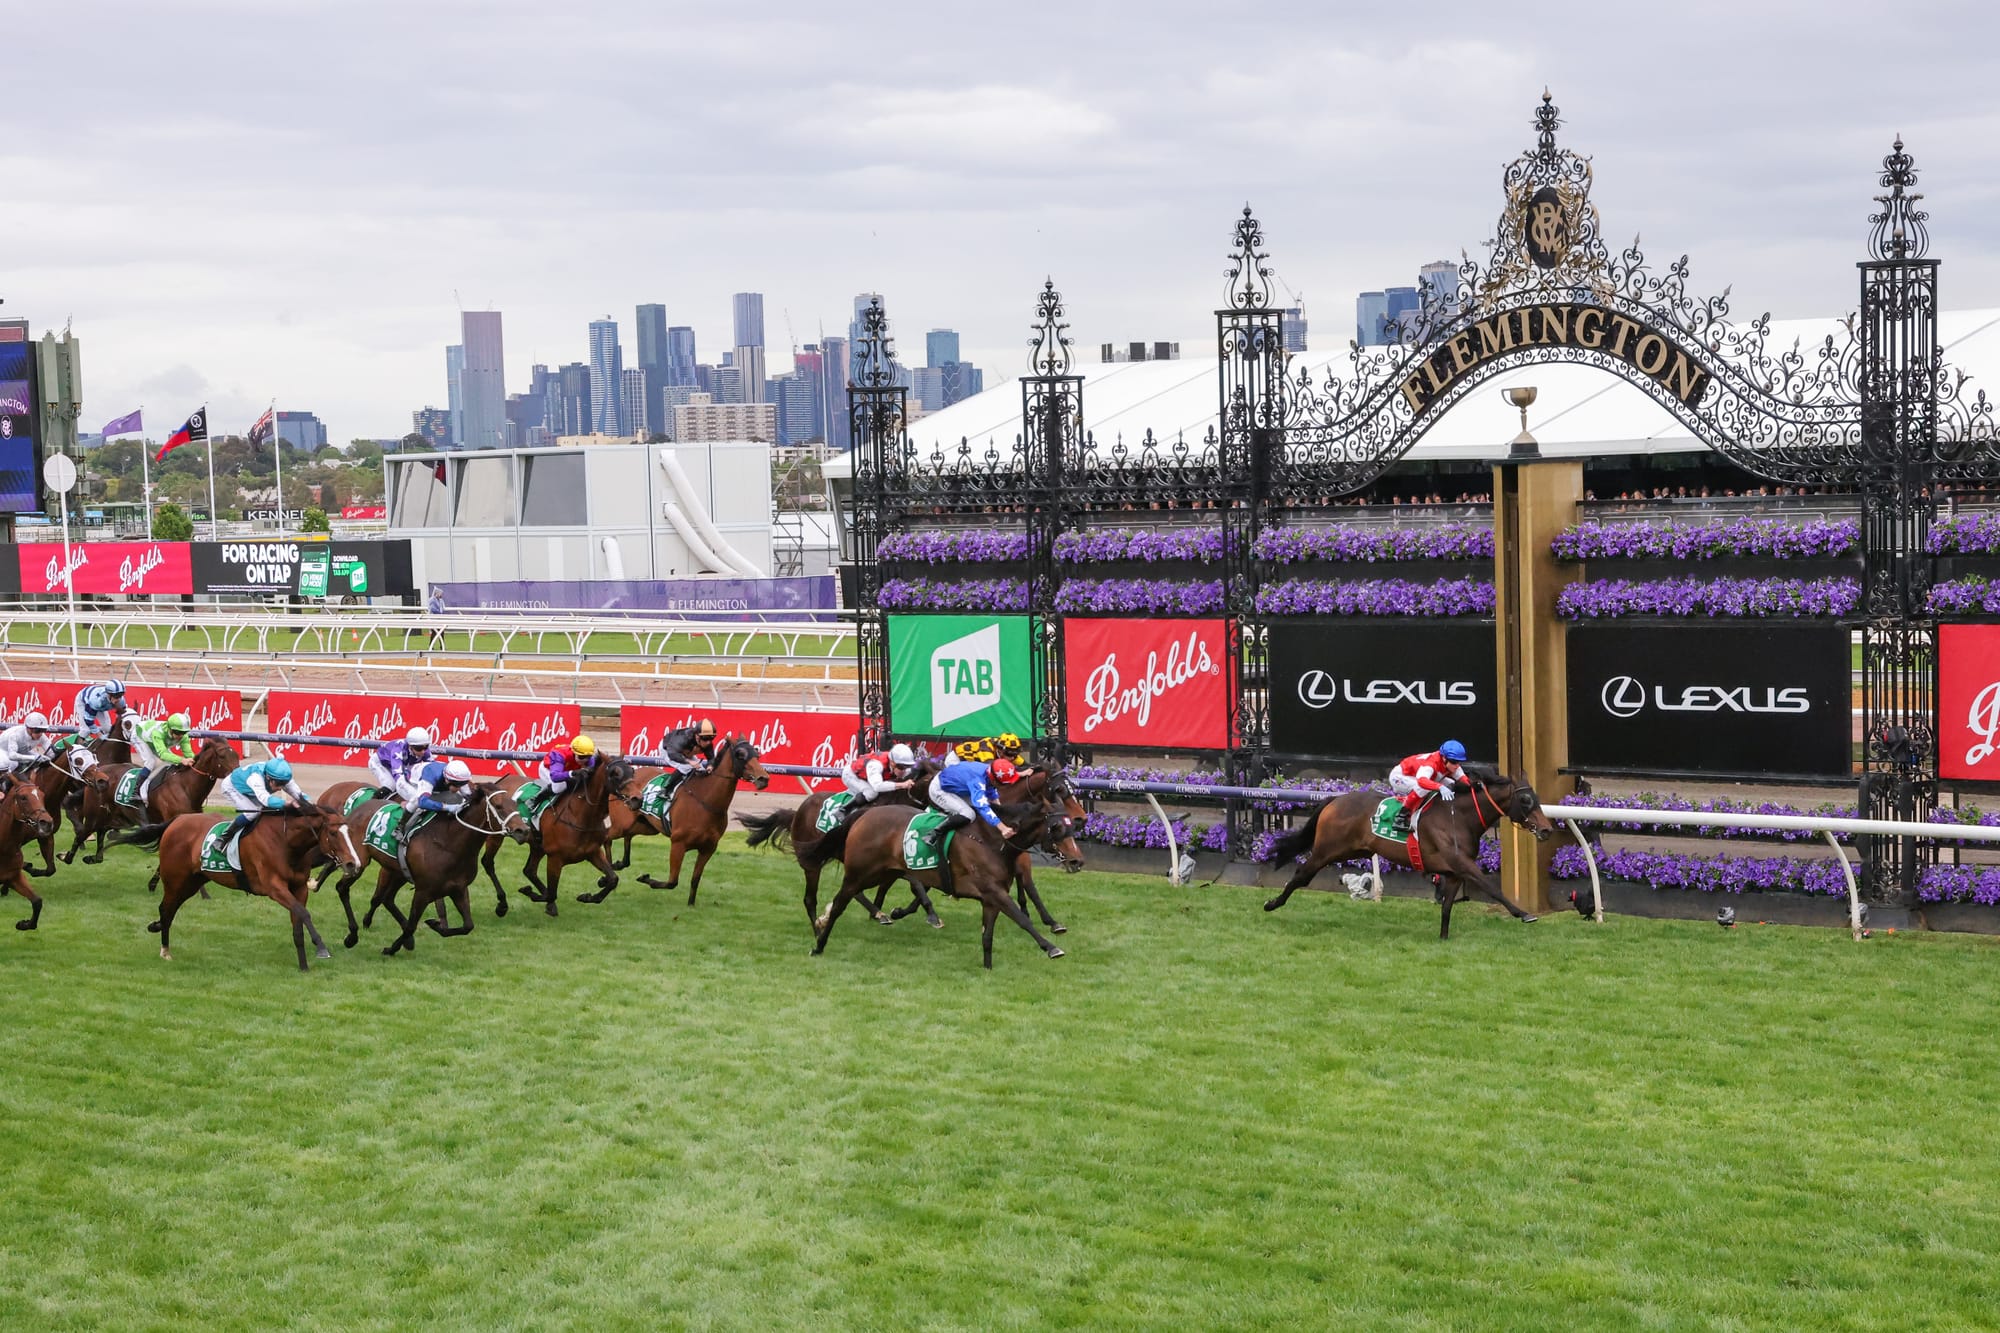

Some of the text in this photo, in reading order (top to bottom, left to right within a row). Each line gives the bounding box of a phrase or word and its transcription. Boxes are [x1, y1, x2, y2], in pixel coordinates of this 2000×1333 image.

[1401, 306, 1705, 414] FLEMINGTON
[222, 544, 299, 563] FOR RACING
[119, 544, 163, 592] Penfolds
[246, 564, 291, 583] ON TAP
[678, 600, 748, 609] FLEMINGTON
[938, 659, 994, 695] TAB
[1084, 631, 1212, 733] Penfolds
[1343, 679, 1476, 705] LEXUS
[1655, 685, 1810, 713] LEXUS
[1175, 785, 1210, 794] FLEMINGTON
[1242, 790, 1278, 799] FLEMINGTON
